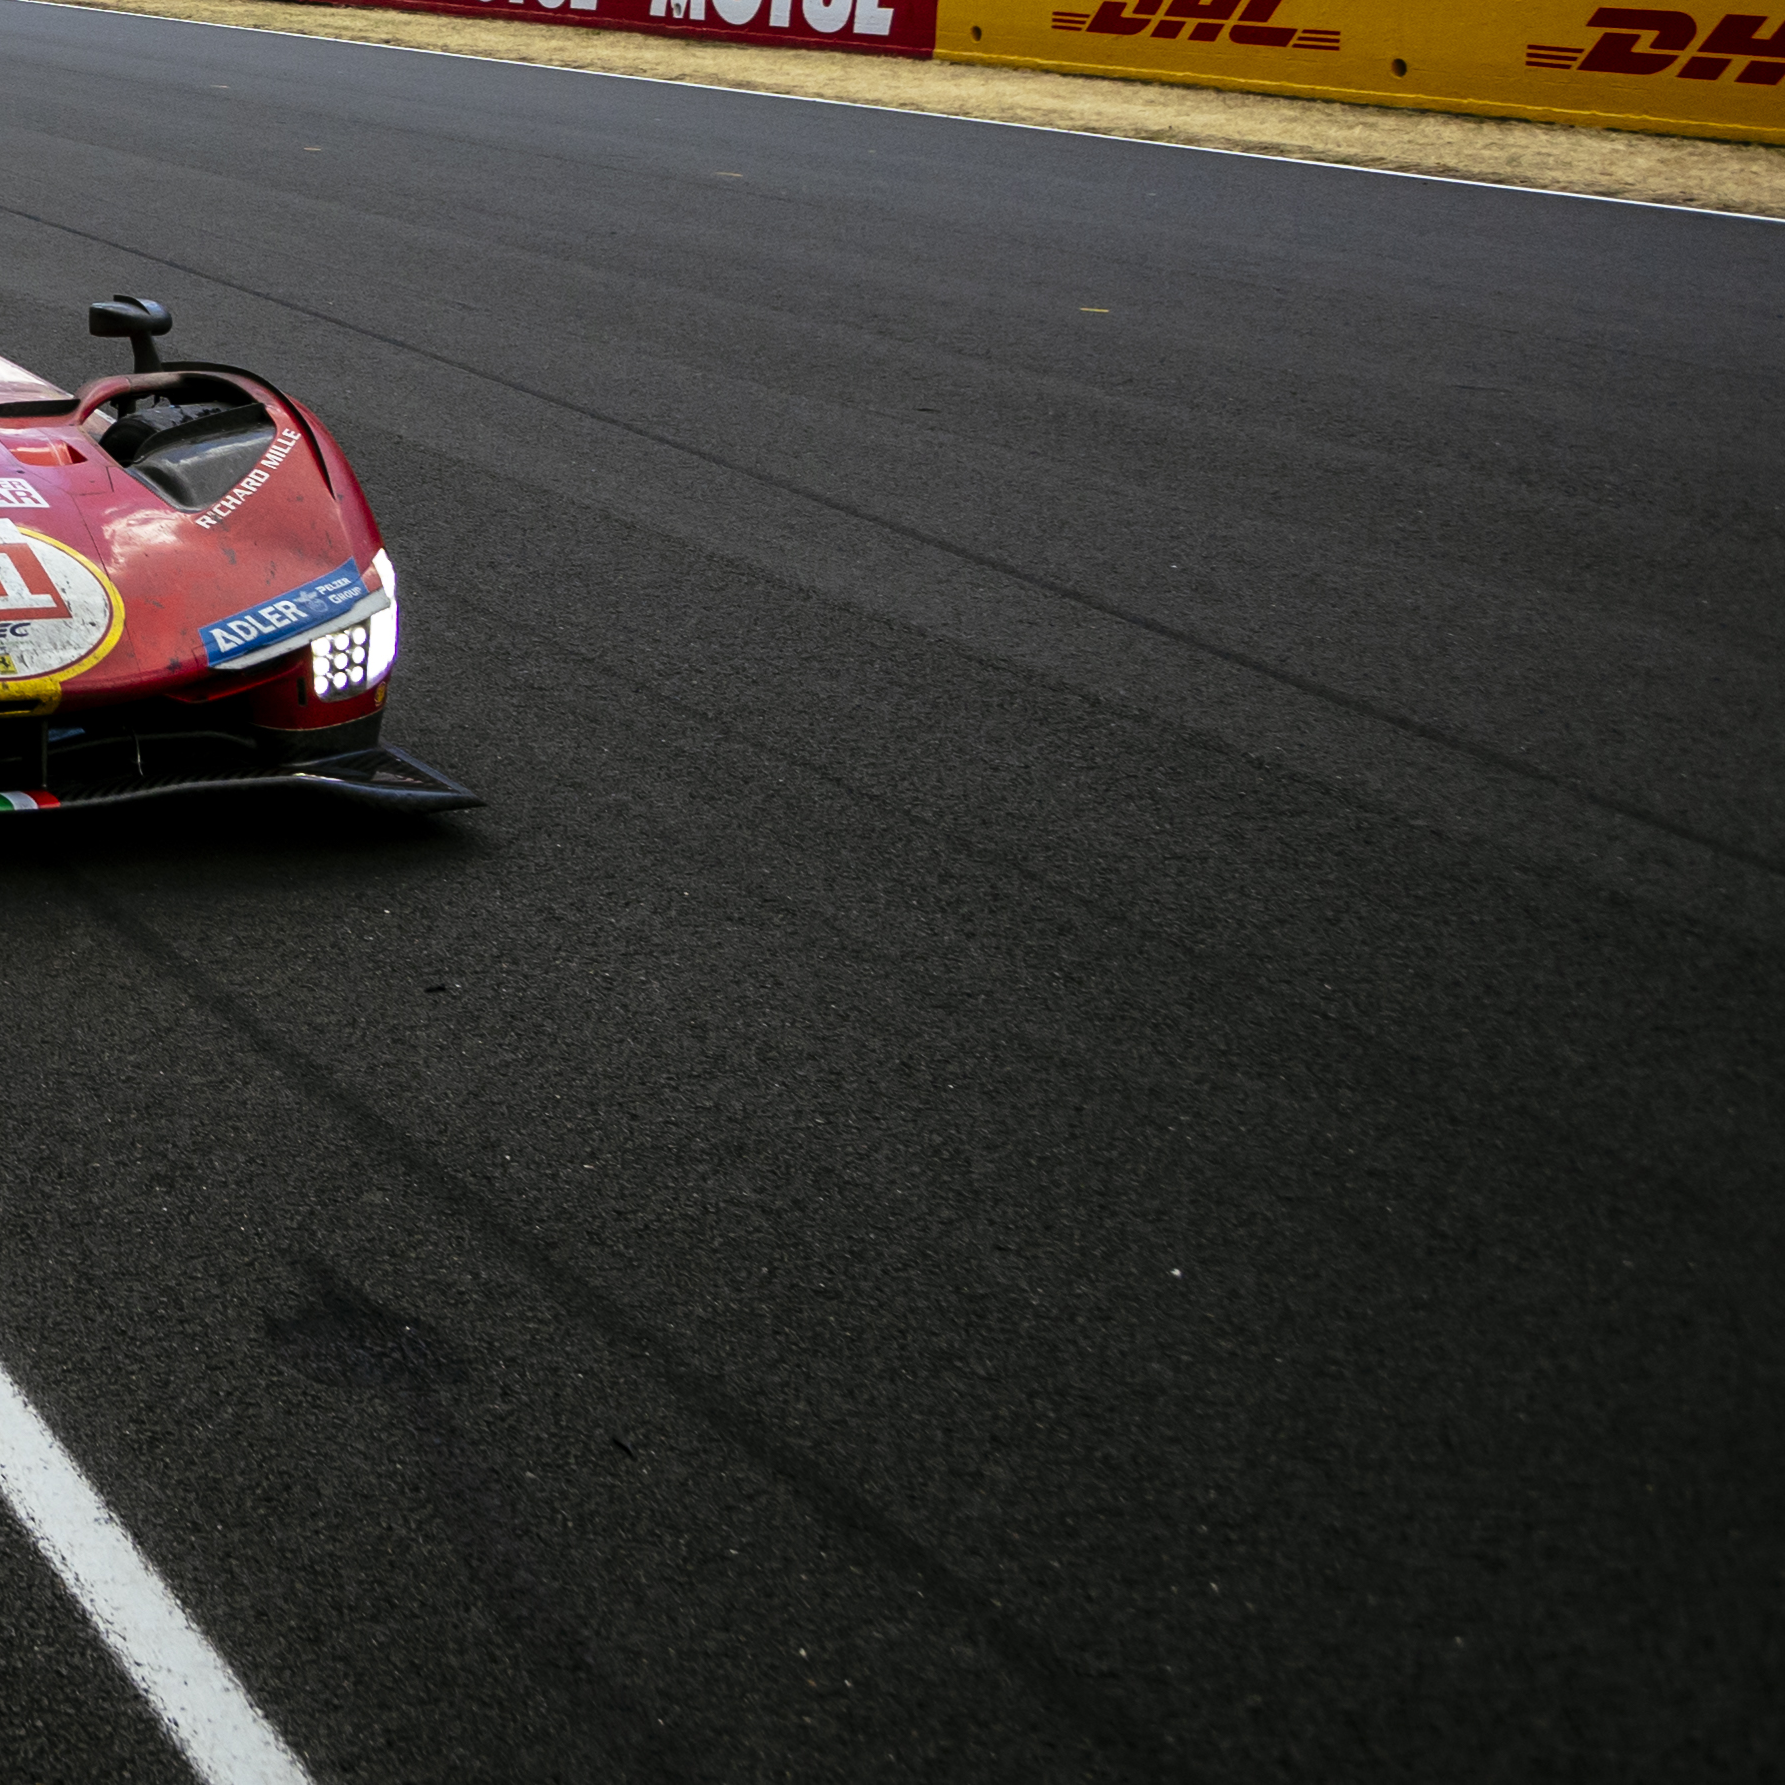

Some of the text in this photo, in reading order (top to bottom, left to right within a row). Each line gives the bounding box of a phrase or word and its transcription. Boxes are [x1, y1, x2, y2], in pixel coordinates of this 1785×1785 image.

[1576, 7, 1785, 87] DH
[261, 427, 302, 472] MILLE
[315, 577, 351, 595] PELZER
[209, 600, 308, 653] ADLER
